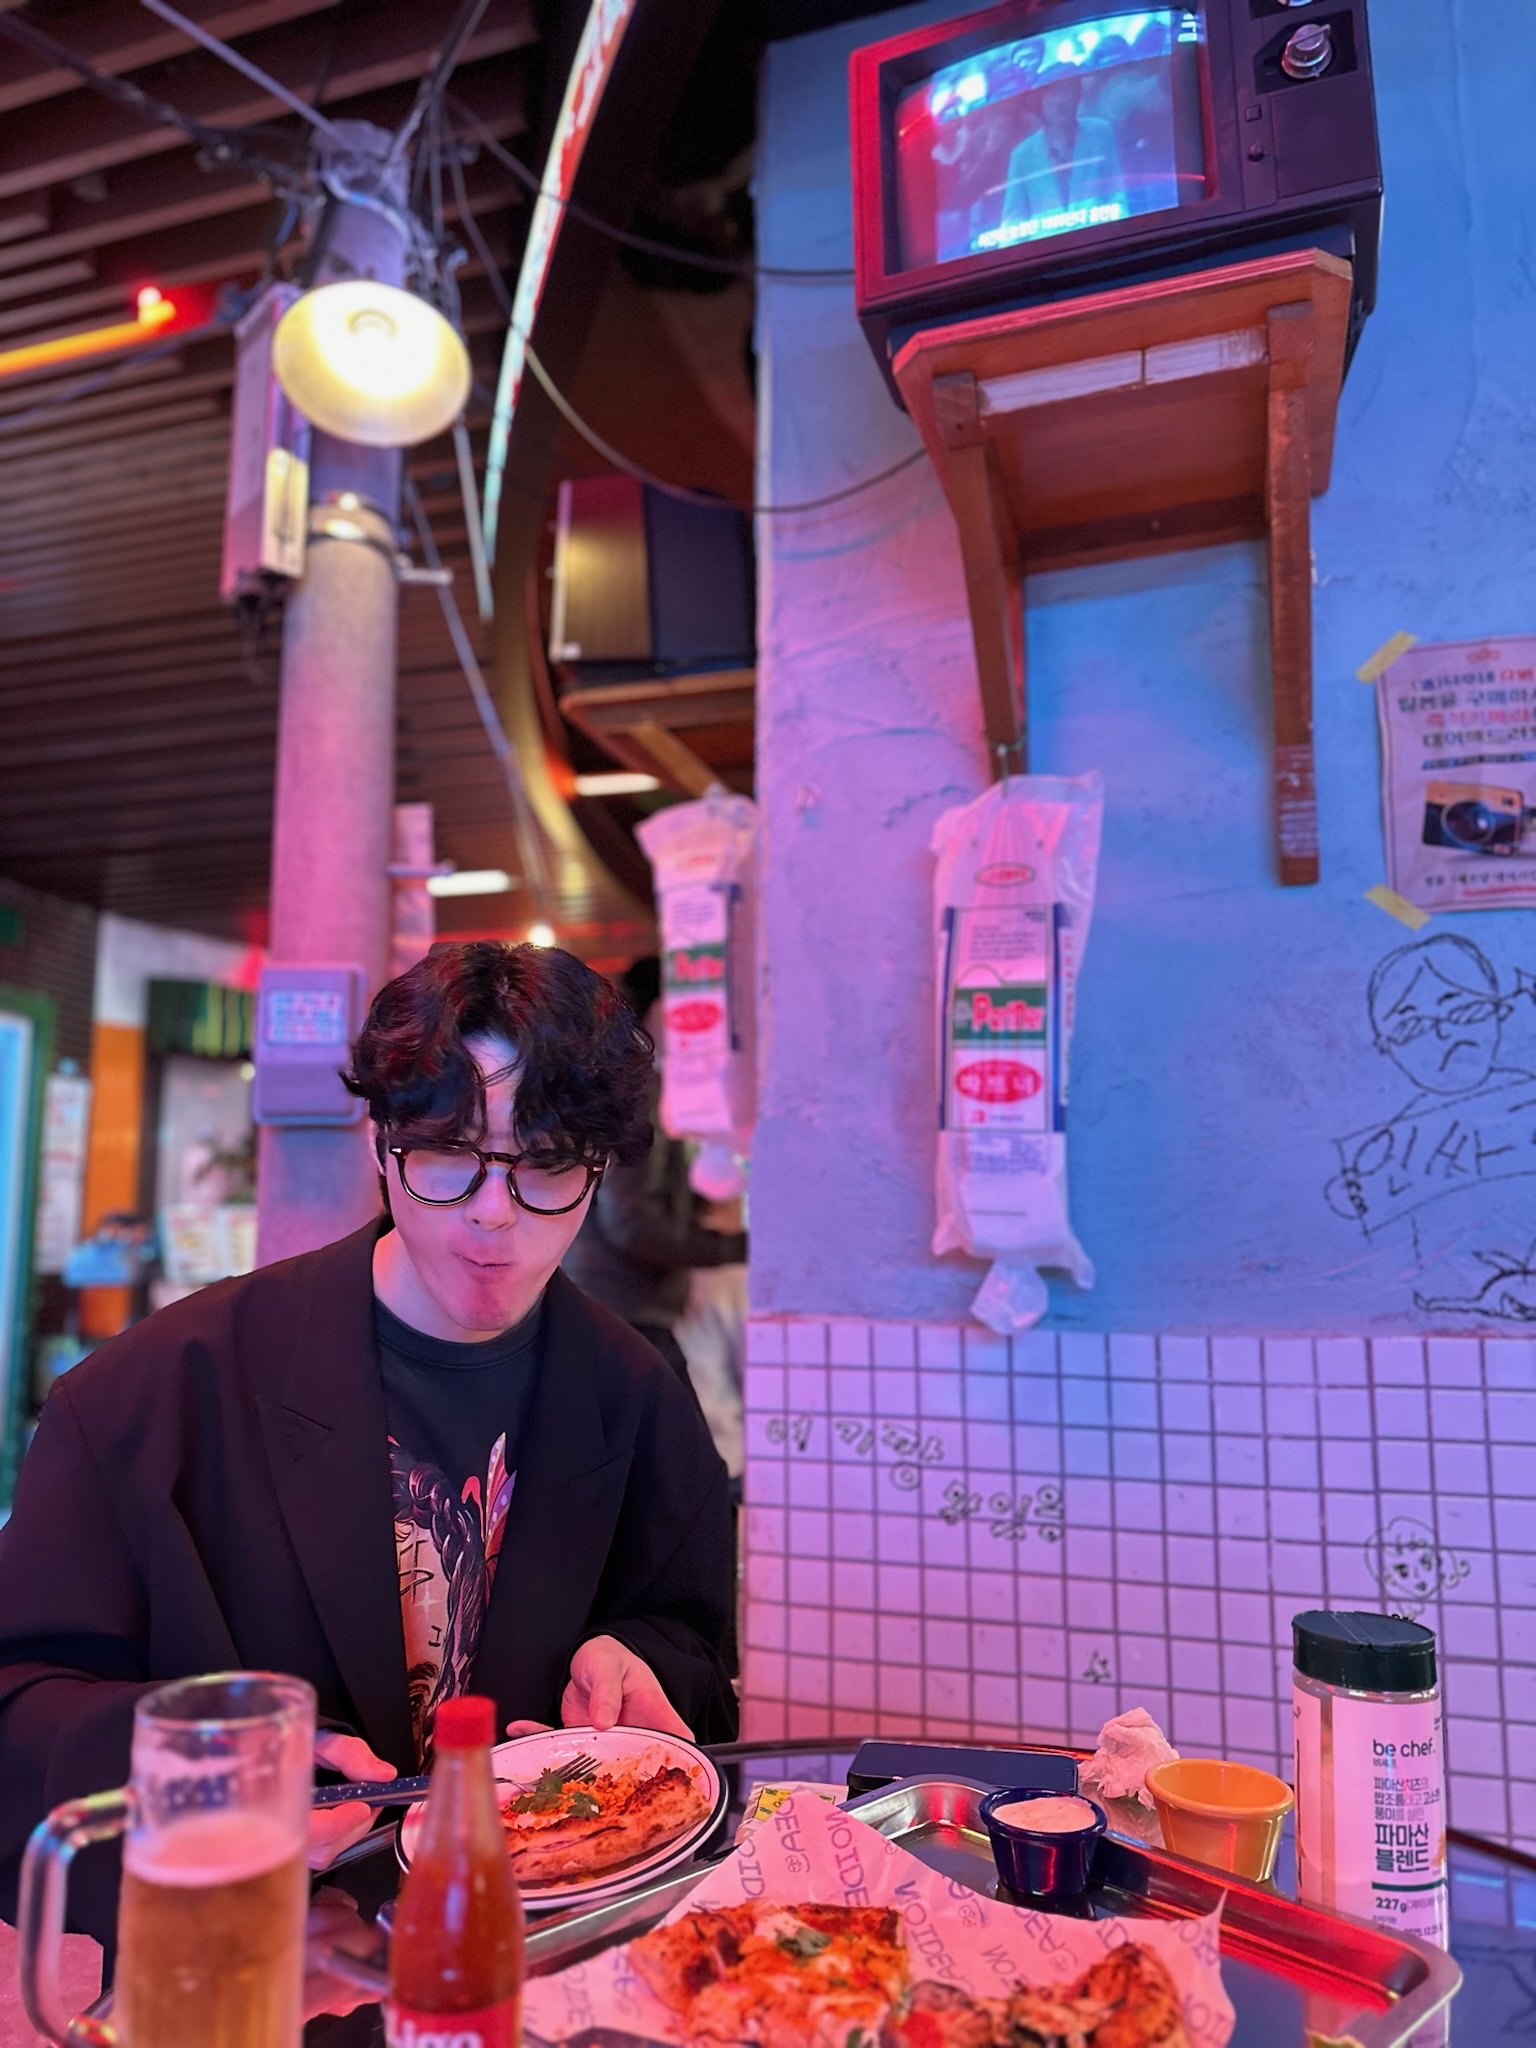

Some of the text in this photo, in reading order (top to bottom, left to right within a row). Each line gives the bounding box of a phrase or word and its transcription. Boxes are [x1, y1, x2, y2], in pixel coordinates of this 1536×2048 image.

[1373, 1738, 1397, 1757] be
[1375, 1822, 1429, 1848] 파마산
[1375, 1847, 1430, 1873] 블렌드
